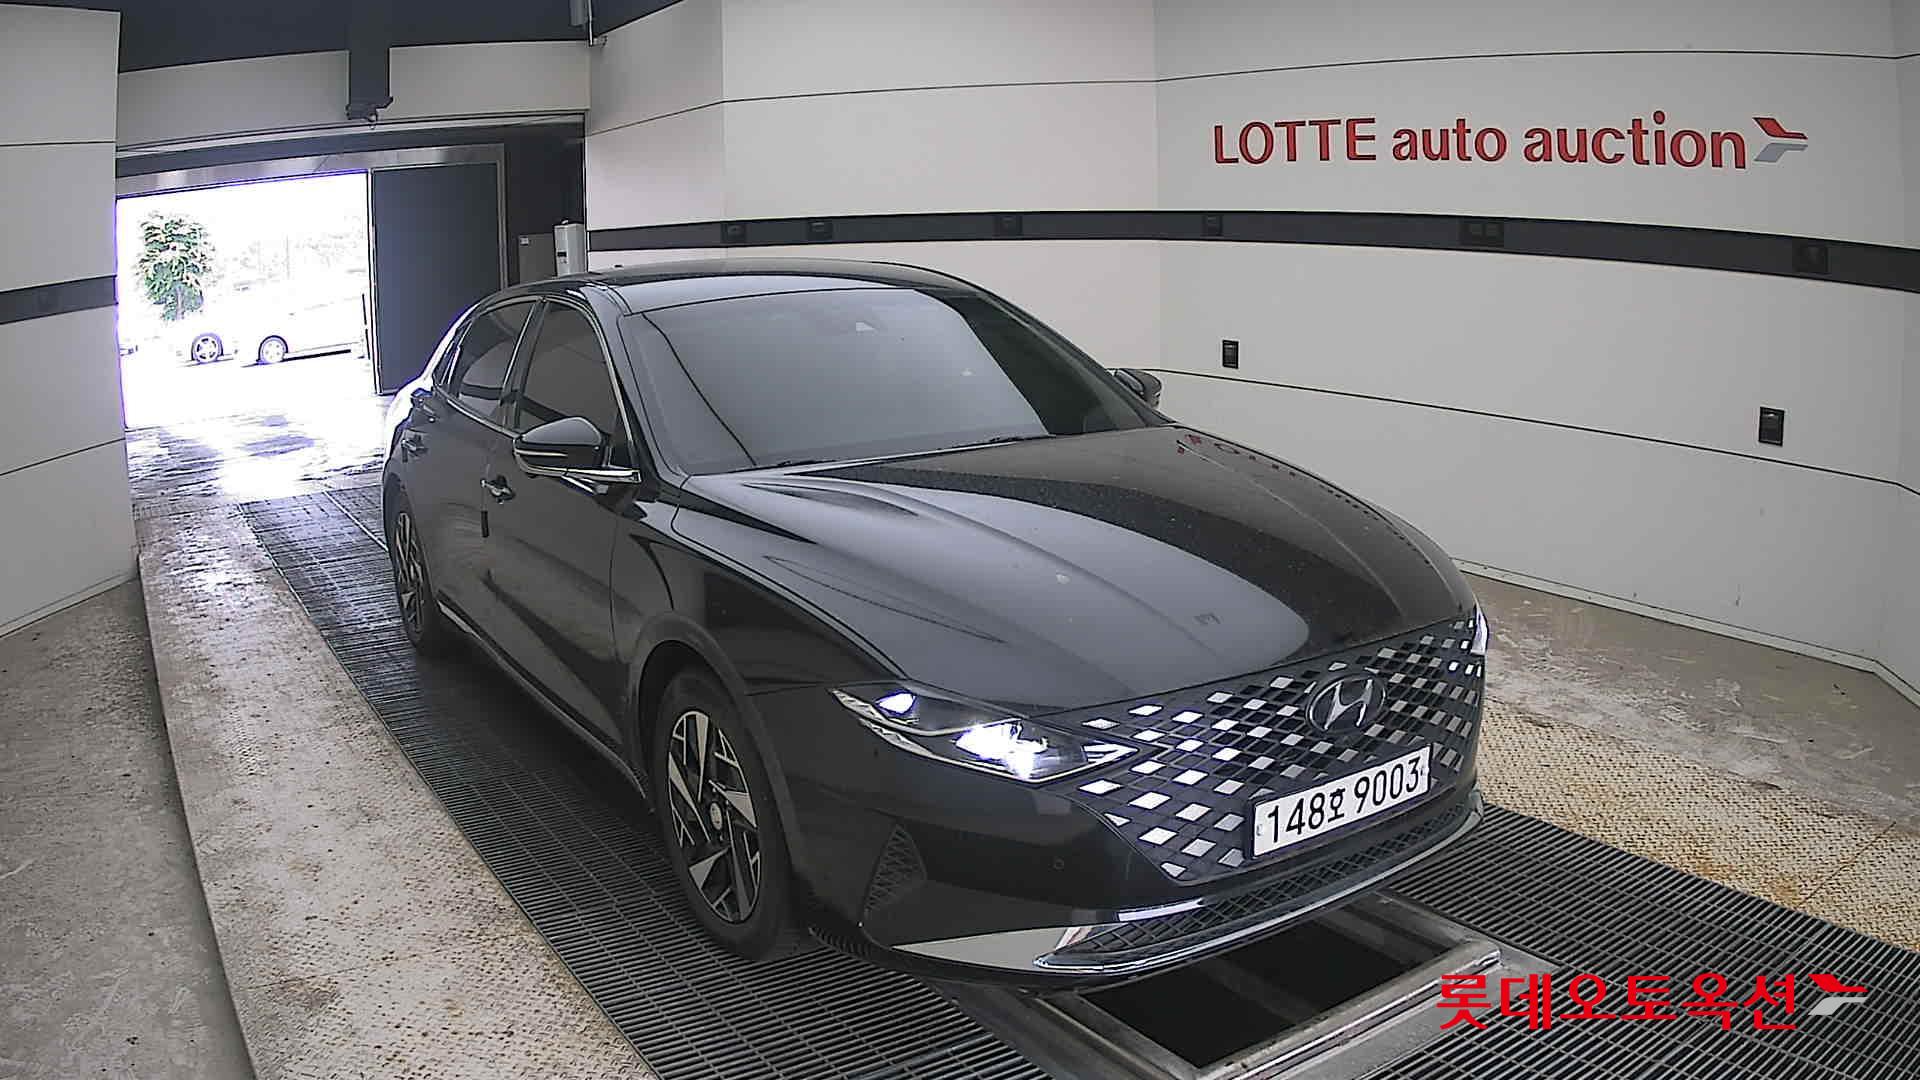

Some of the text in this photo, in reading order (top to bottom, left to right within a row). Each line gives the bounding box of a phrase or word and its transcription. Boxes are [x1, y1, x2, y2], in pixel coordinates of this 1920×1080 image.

[1214, 110, 1746, 169] LOTTE auto auction
[1267, 756, 1421, 843] 148호 9003
